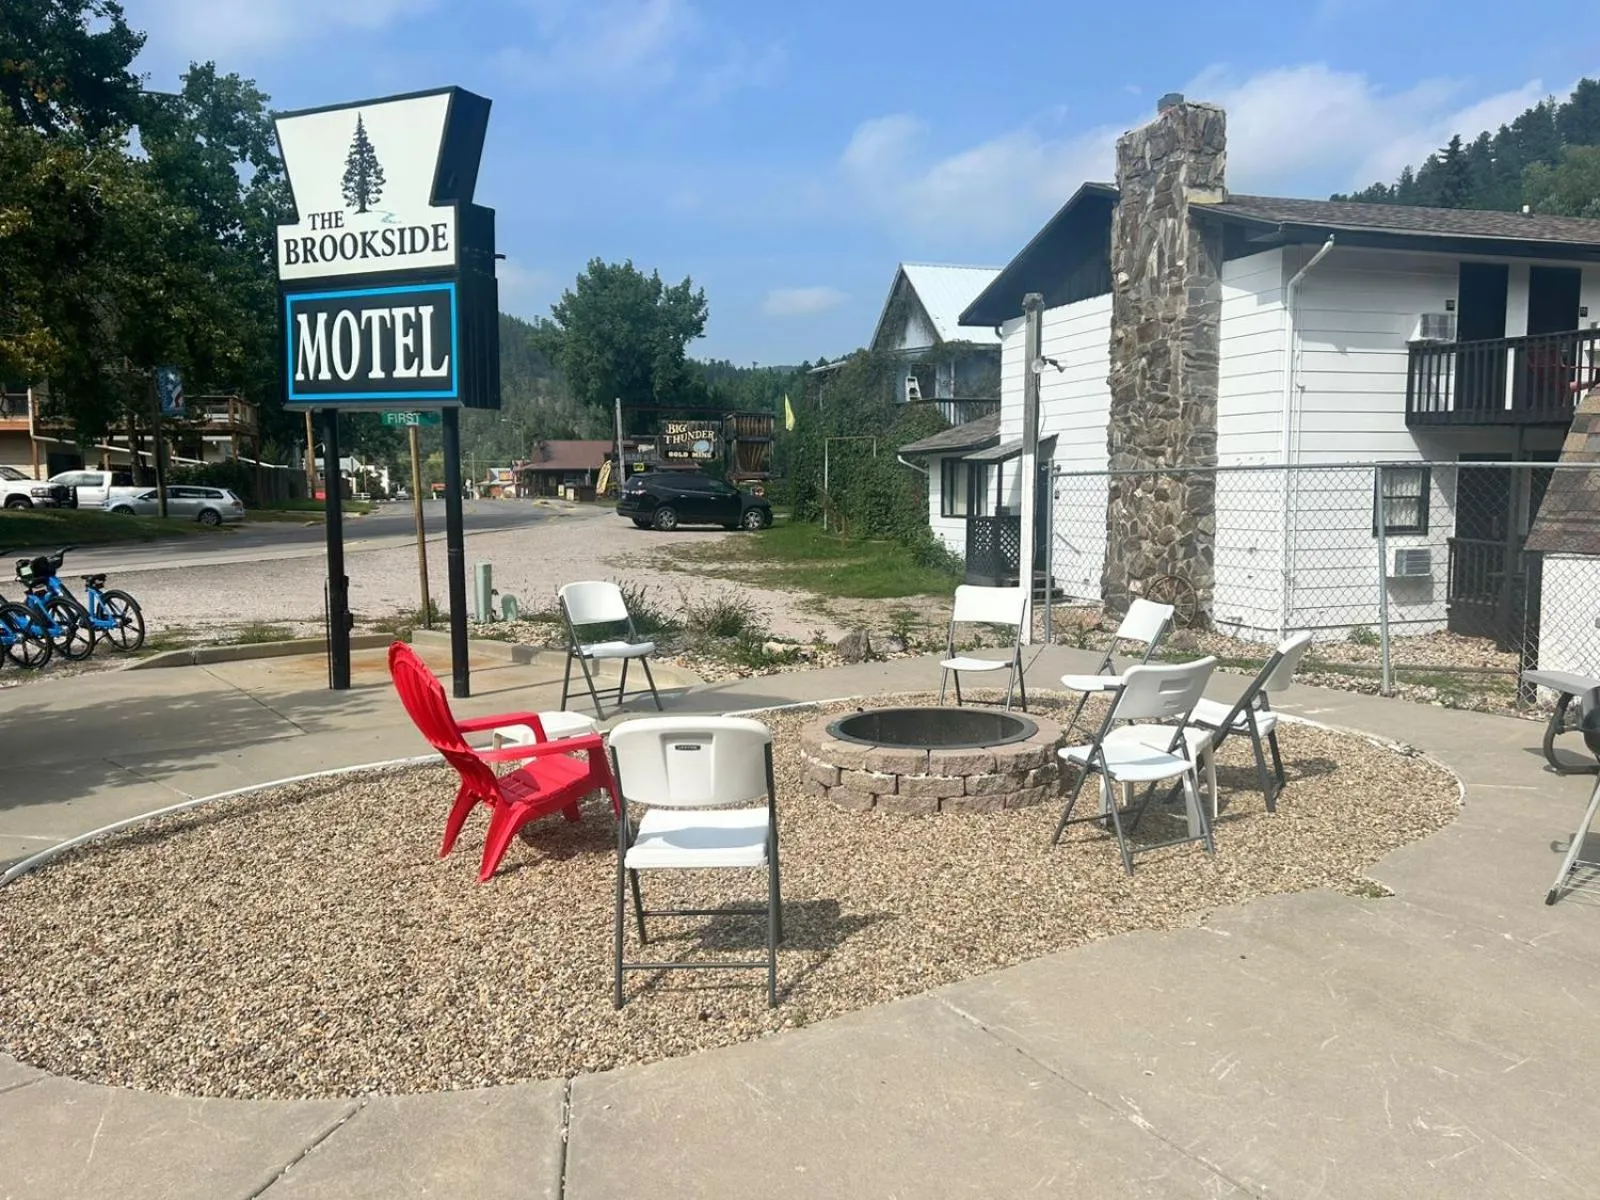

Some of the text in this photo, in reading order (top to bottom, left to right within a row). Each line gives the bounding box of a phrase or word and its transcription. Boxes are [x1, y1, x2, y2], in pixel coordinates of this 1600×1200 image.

[308, 211, 344, 231] THE
[284, 223, 449, 265] BROOKSIDE
[295, 305, 449, 381] MOTEL
[387, 412, 420, 425] FIRST
[664, 430, 717, 444] THUNDER
[666, 423, 687, 434] BIG
